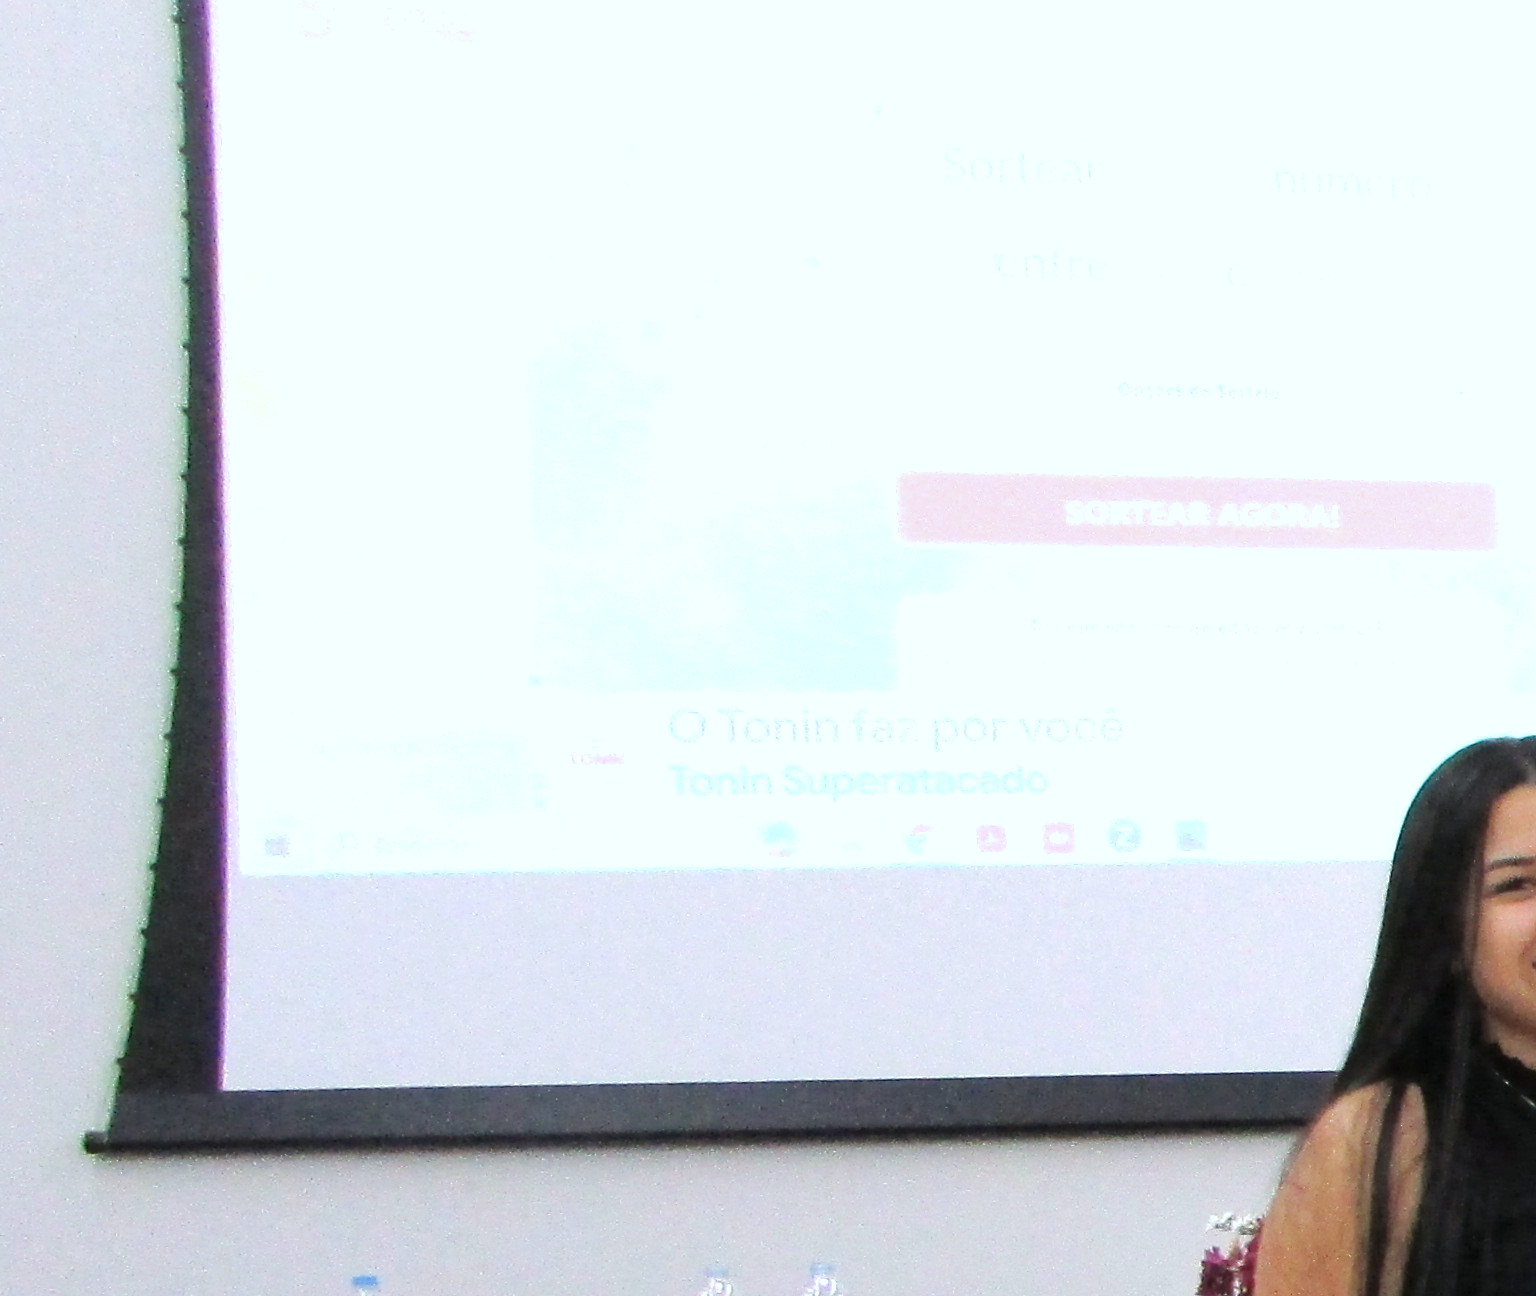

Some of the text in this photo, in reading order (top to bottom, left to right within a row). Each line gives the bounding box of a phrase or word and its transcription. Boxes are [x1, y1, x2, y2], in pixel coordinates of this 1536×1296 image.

[941, 145, 1104, 186] Sortear
[1063, 499, 1343, 529] SORTEAR AGORA!
[667, 706, 1125, 753] O Tonin faz por você
[667, 763, 1050, 803] Tonin Superatacado
